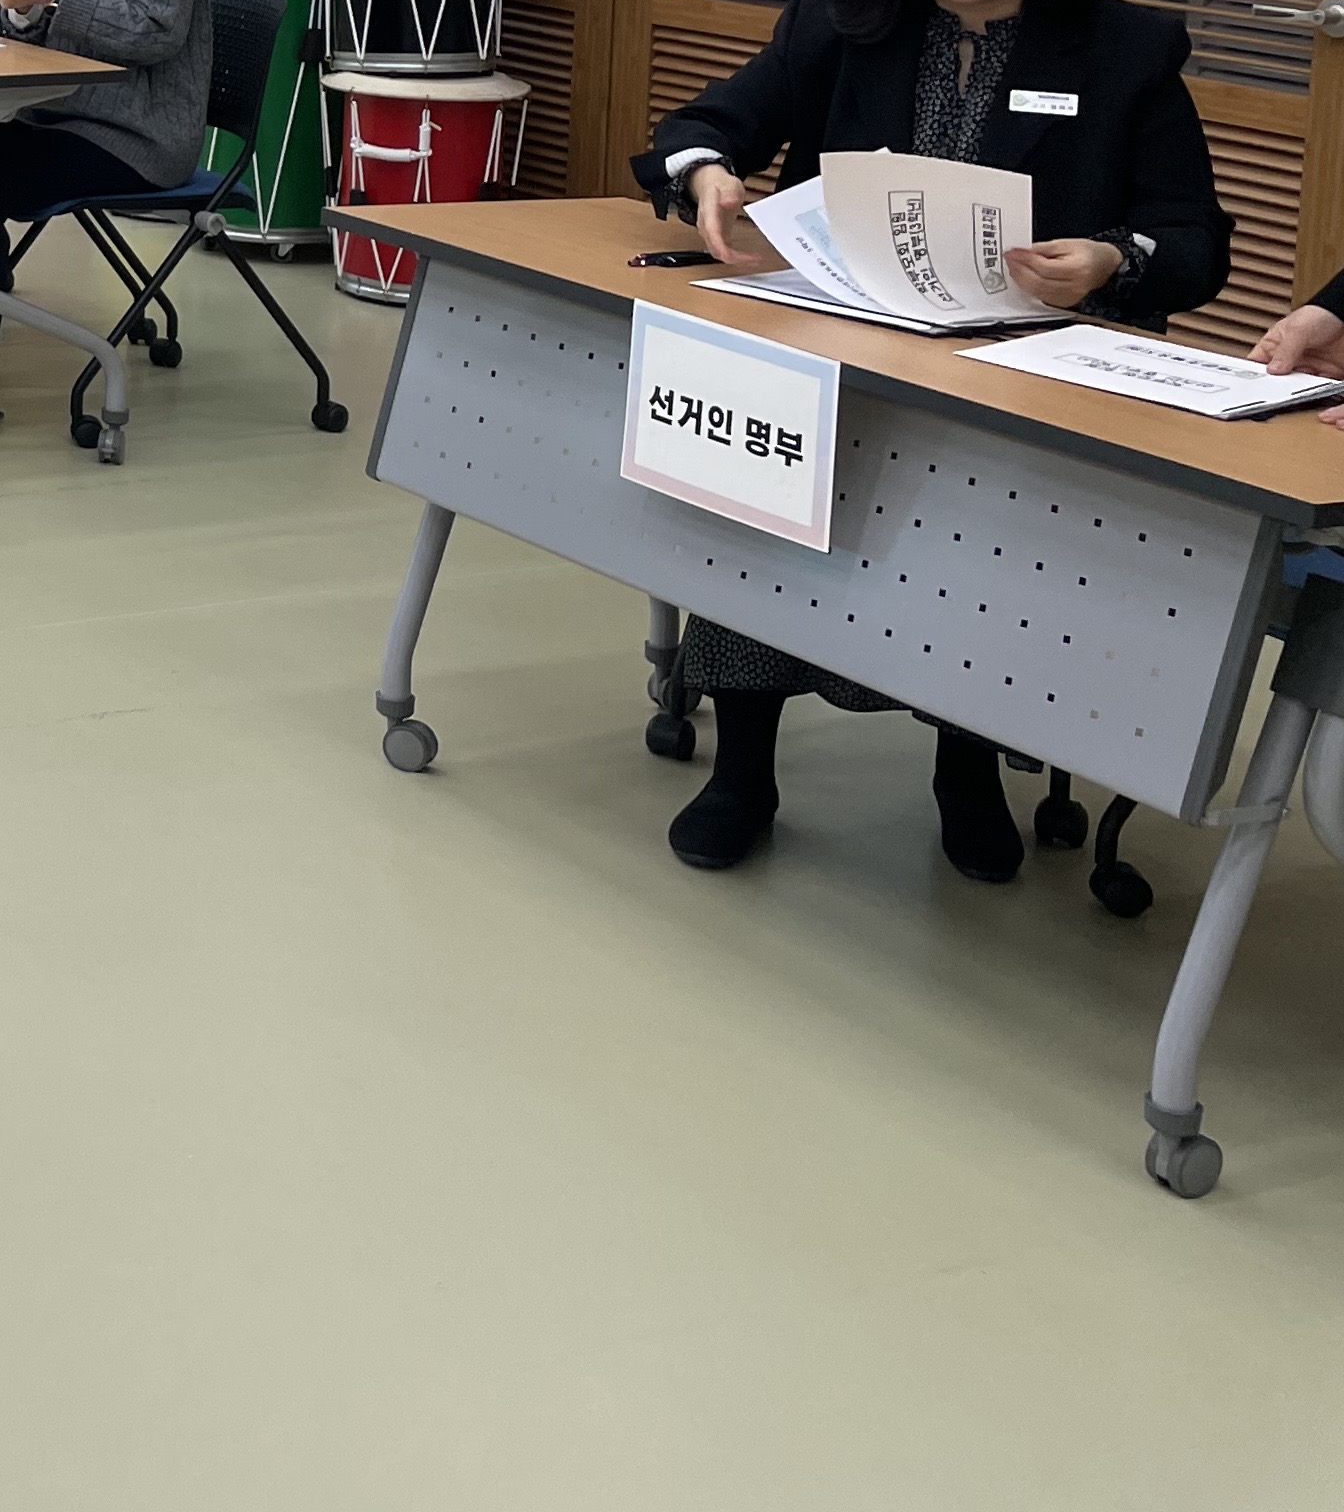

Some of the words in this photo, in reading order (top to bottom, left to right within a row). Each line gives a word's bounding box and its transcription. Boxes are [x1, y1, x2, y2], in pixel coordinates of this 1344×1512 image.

[920, 267, 953, 301] 선거인
[648, 385, 732, 445] 선거인
[744, 416, 803, 467] 명부
